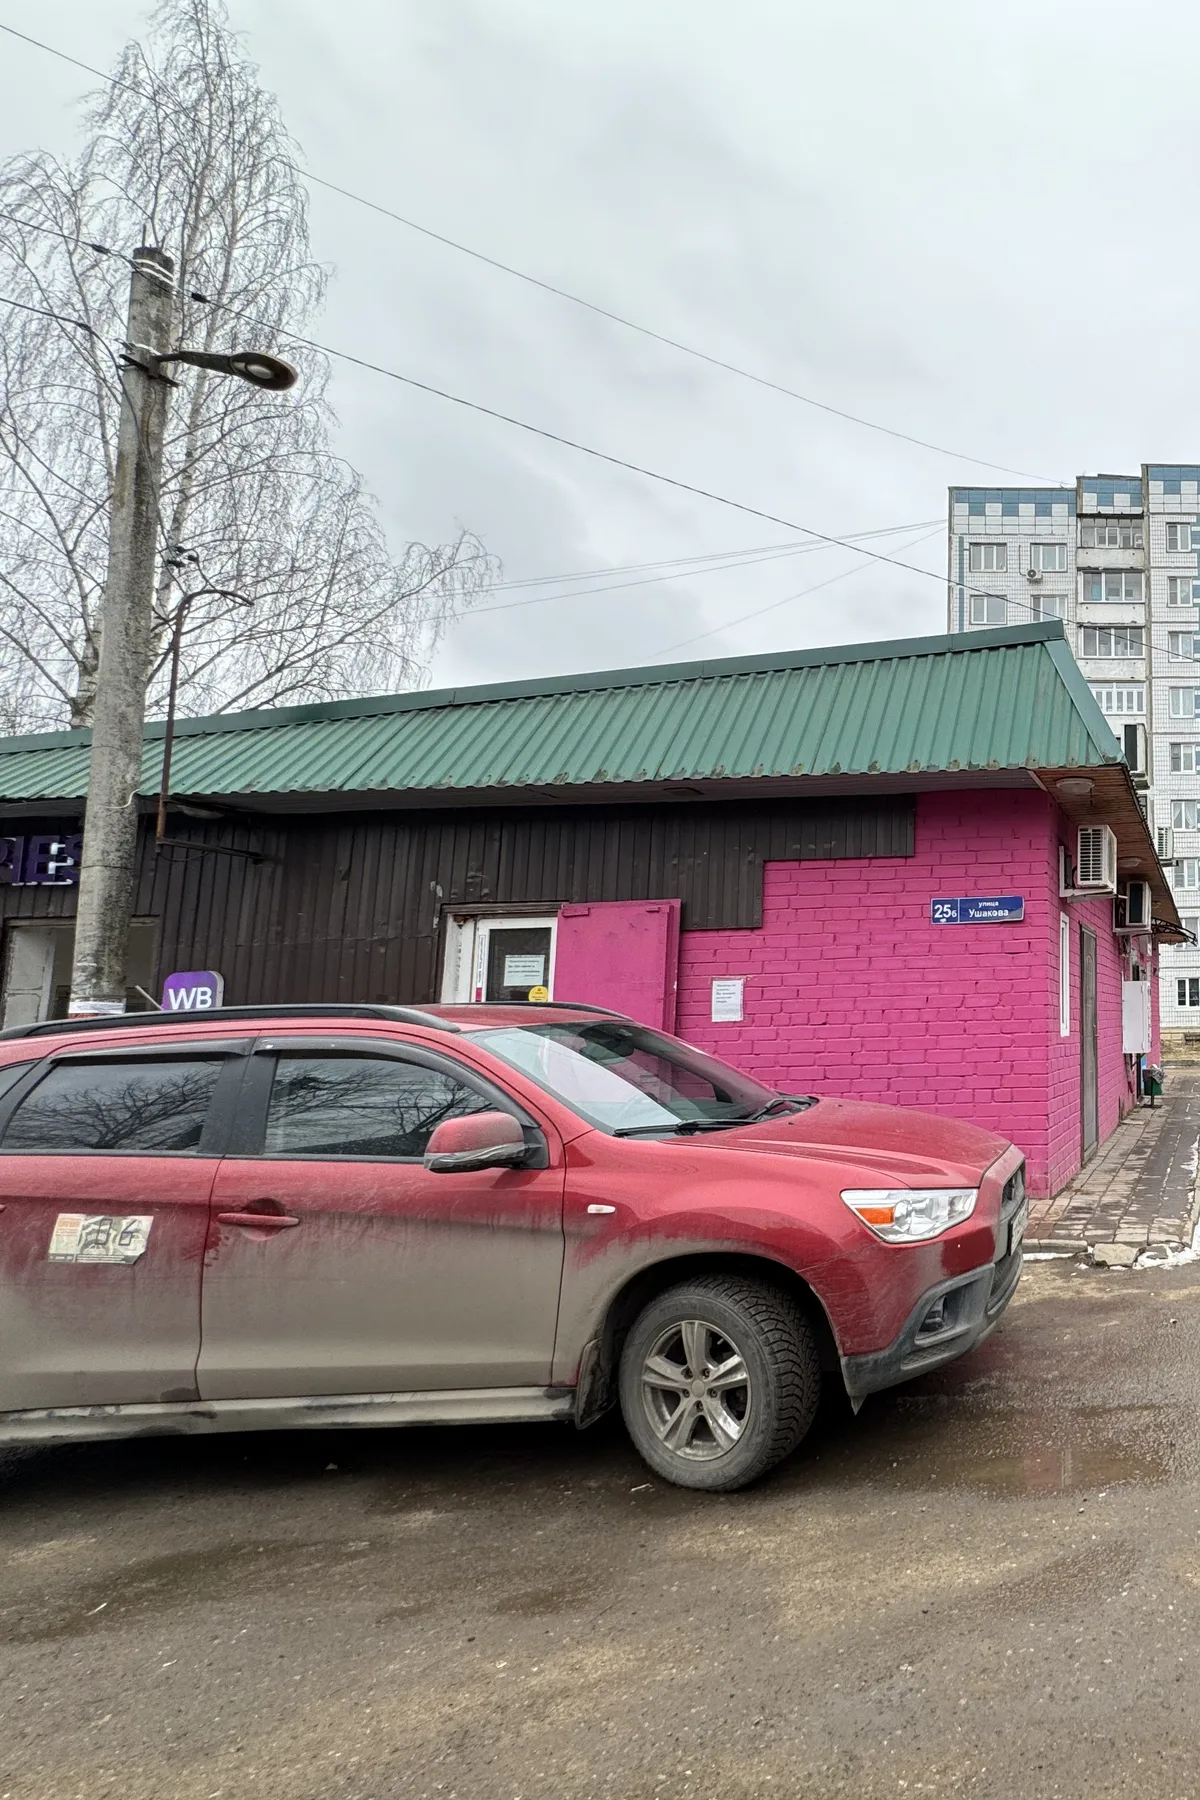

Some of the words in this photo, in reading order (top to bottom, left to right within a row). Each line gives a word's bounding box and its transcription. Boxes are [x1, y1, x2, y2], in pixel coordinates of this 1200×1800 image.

[978, 901, 999, 909] улица
[968, 909, 1010, 918] Ушакова
[168, 986, 213, 1010] WB
